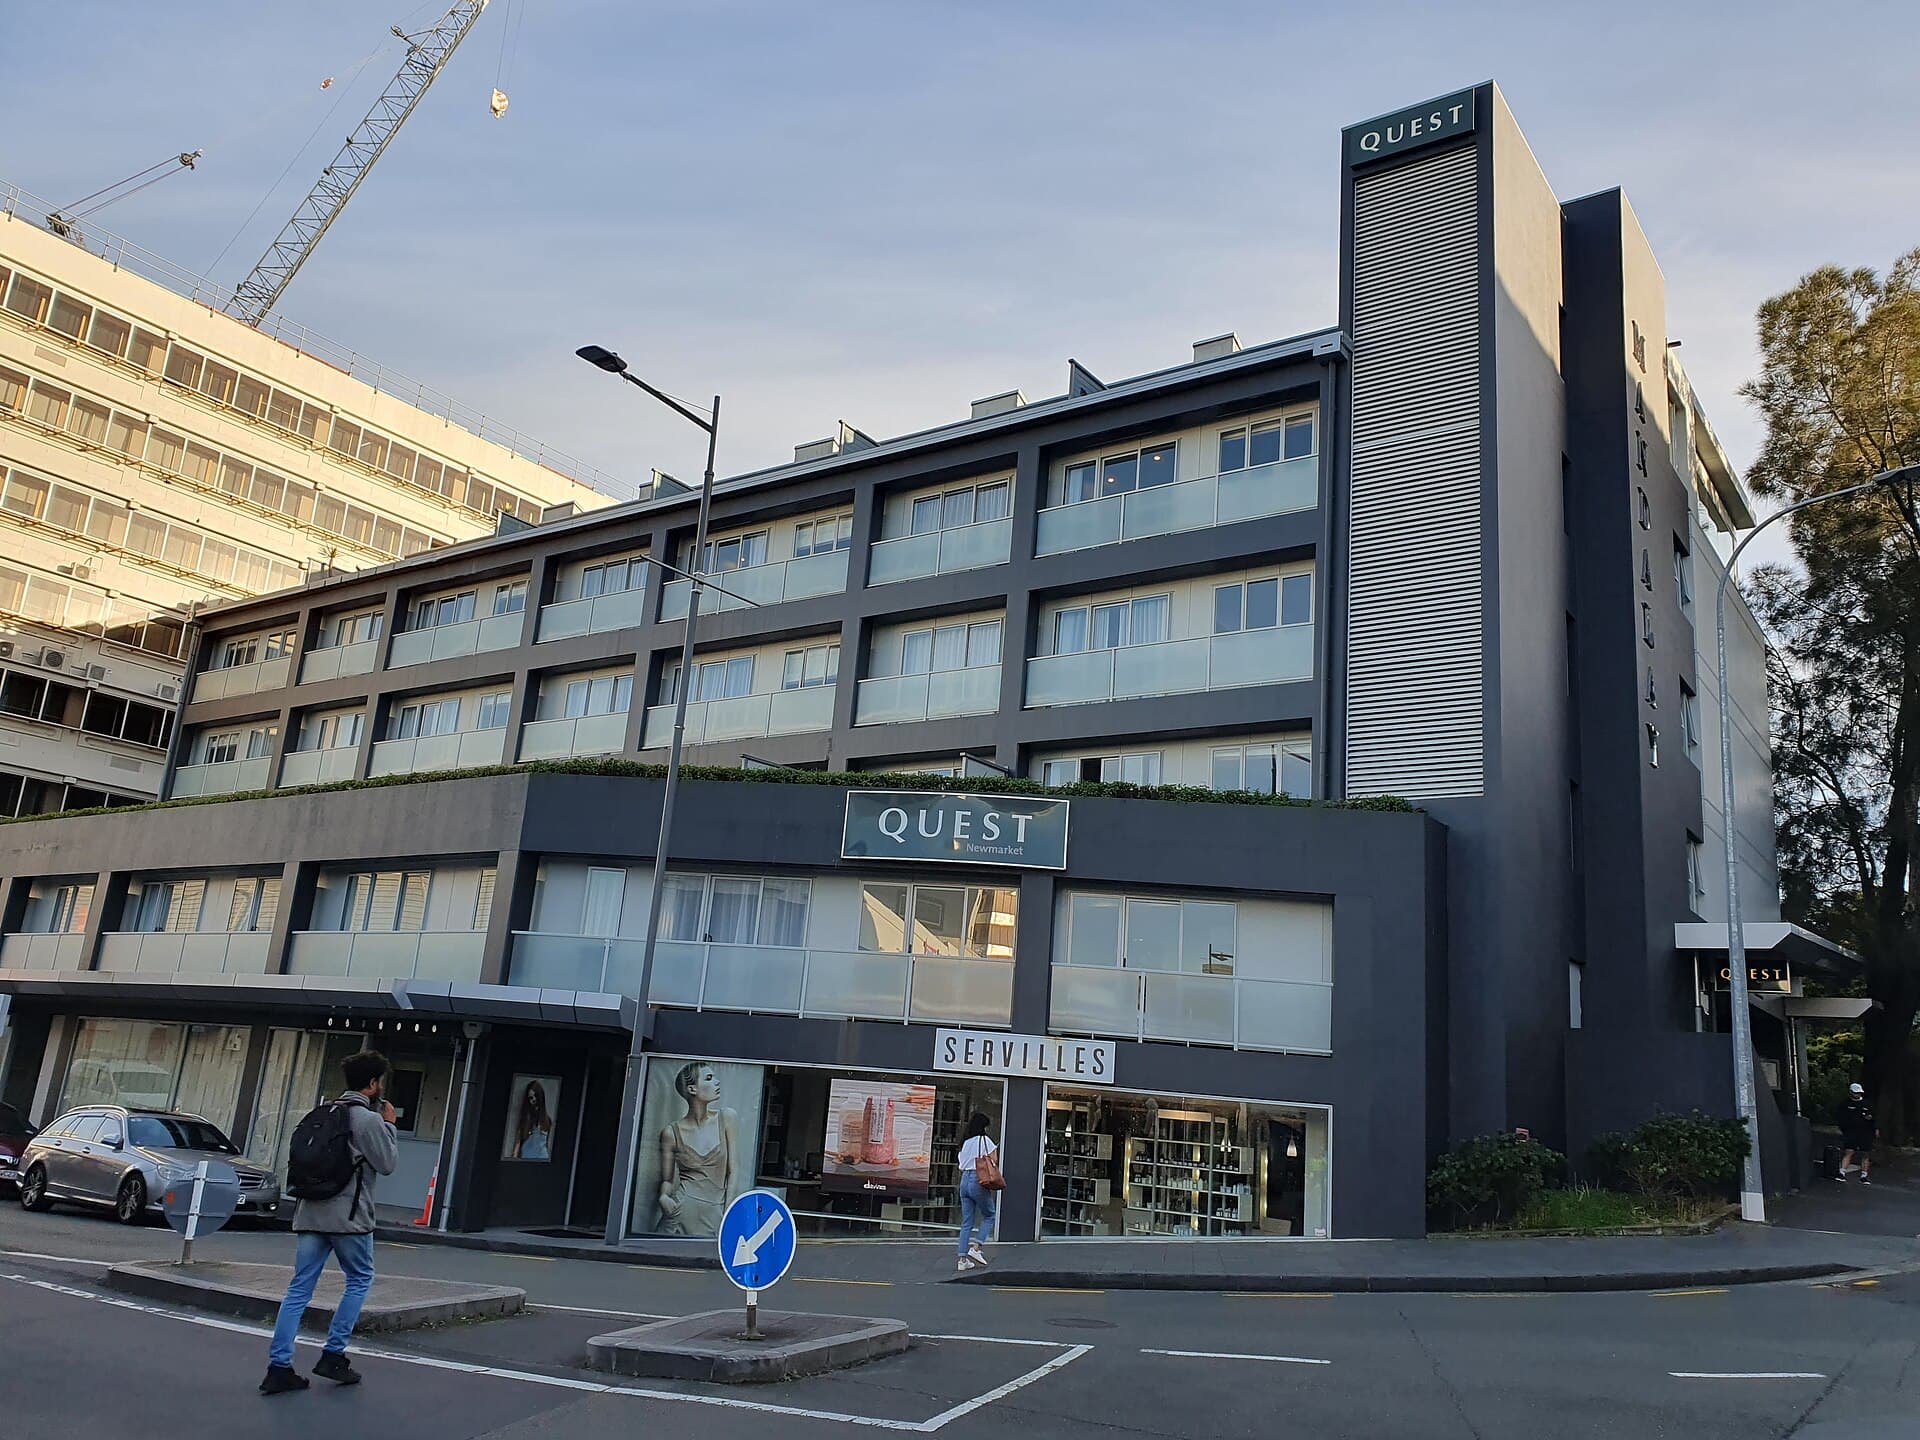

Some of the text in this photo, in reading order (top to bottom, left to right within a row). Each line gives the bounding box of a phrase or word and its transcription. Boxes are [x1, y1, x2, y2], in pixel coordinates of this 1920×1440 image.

[1360, 104, 1463, 152] QUEST
[878, 807, 1033, 844] QUEST
[966, 843, 1024, 856] Newmarket
[1720, 967, 1782, 981] QEST
[944, 1036, 1105, 1075] SERVILLES
